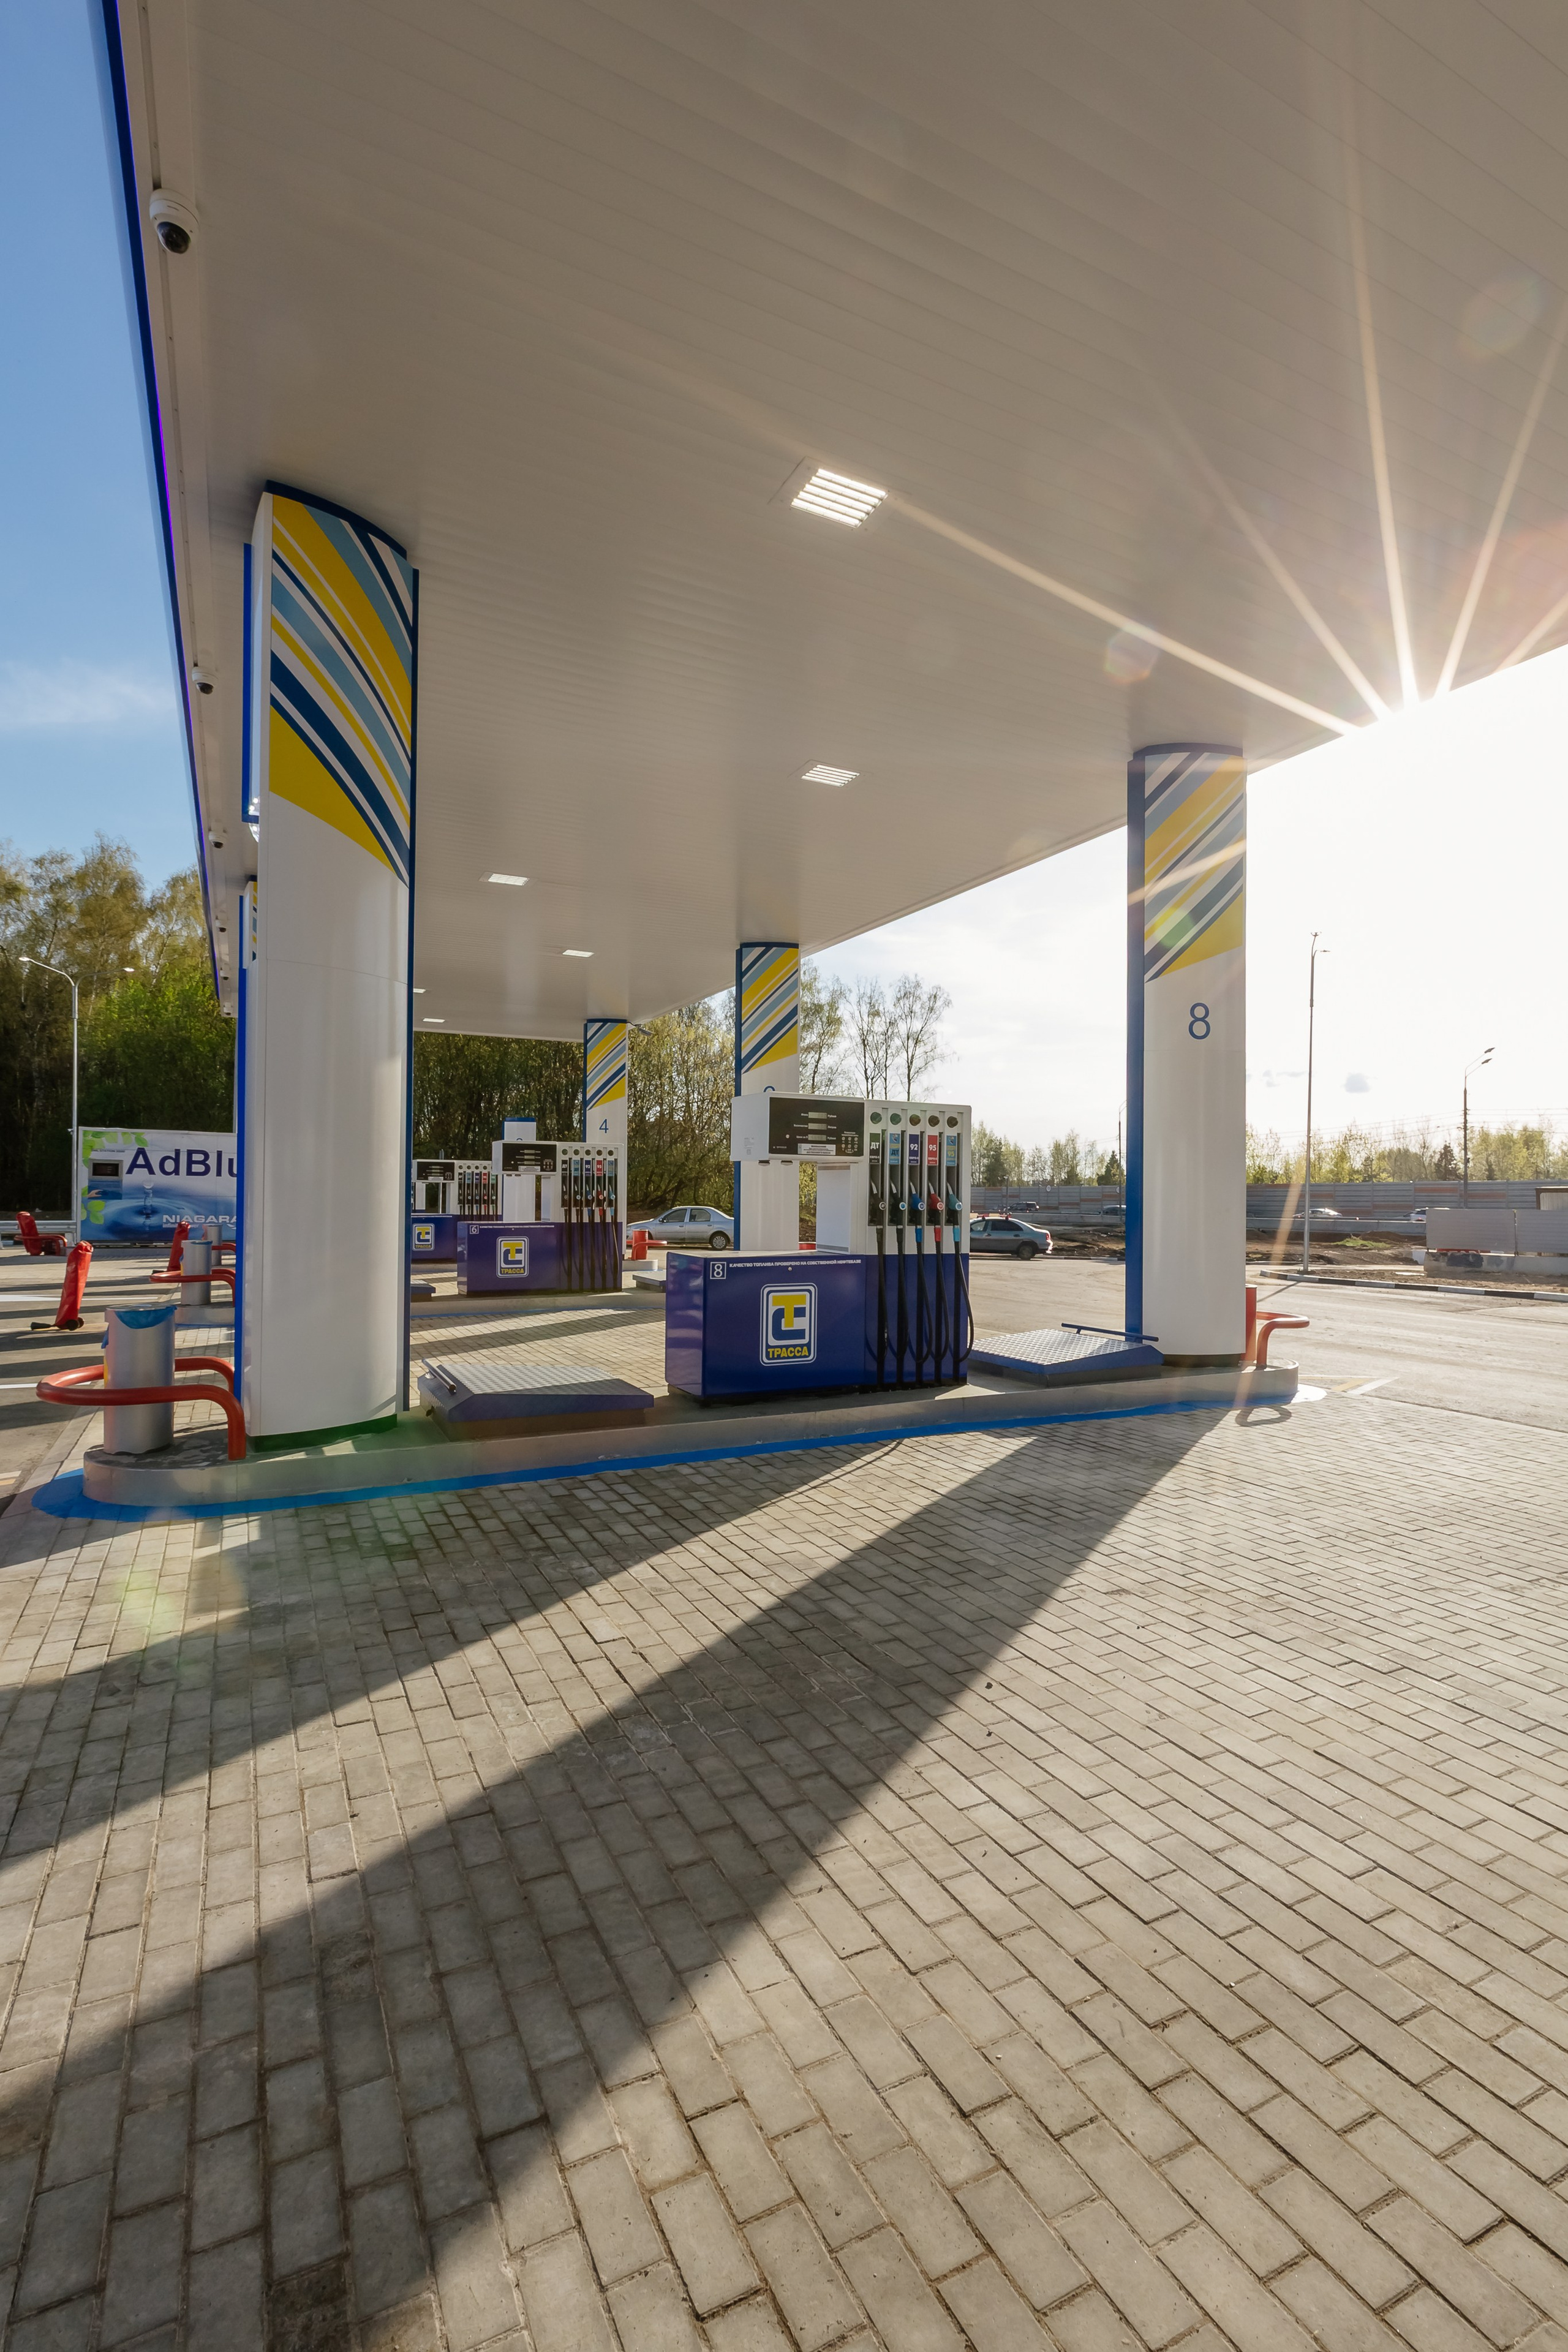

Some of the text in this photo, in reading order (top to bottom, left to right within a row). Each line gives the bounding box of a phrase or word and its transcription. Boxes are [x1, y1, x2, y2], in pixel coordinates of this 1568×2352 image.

[1188, 1002, 1211, 1040] 8
[599, 1118, 609, 1134] 4
[714, 1264, 723, 1278] 8
[767, 1346, 809, 1358] ТРАССА
